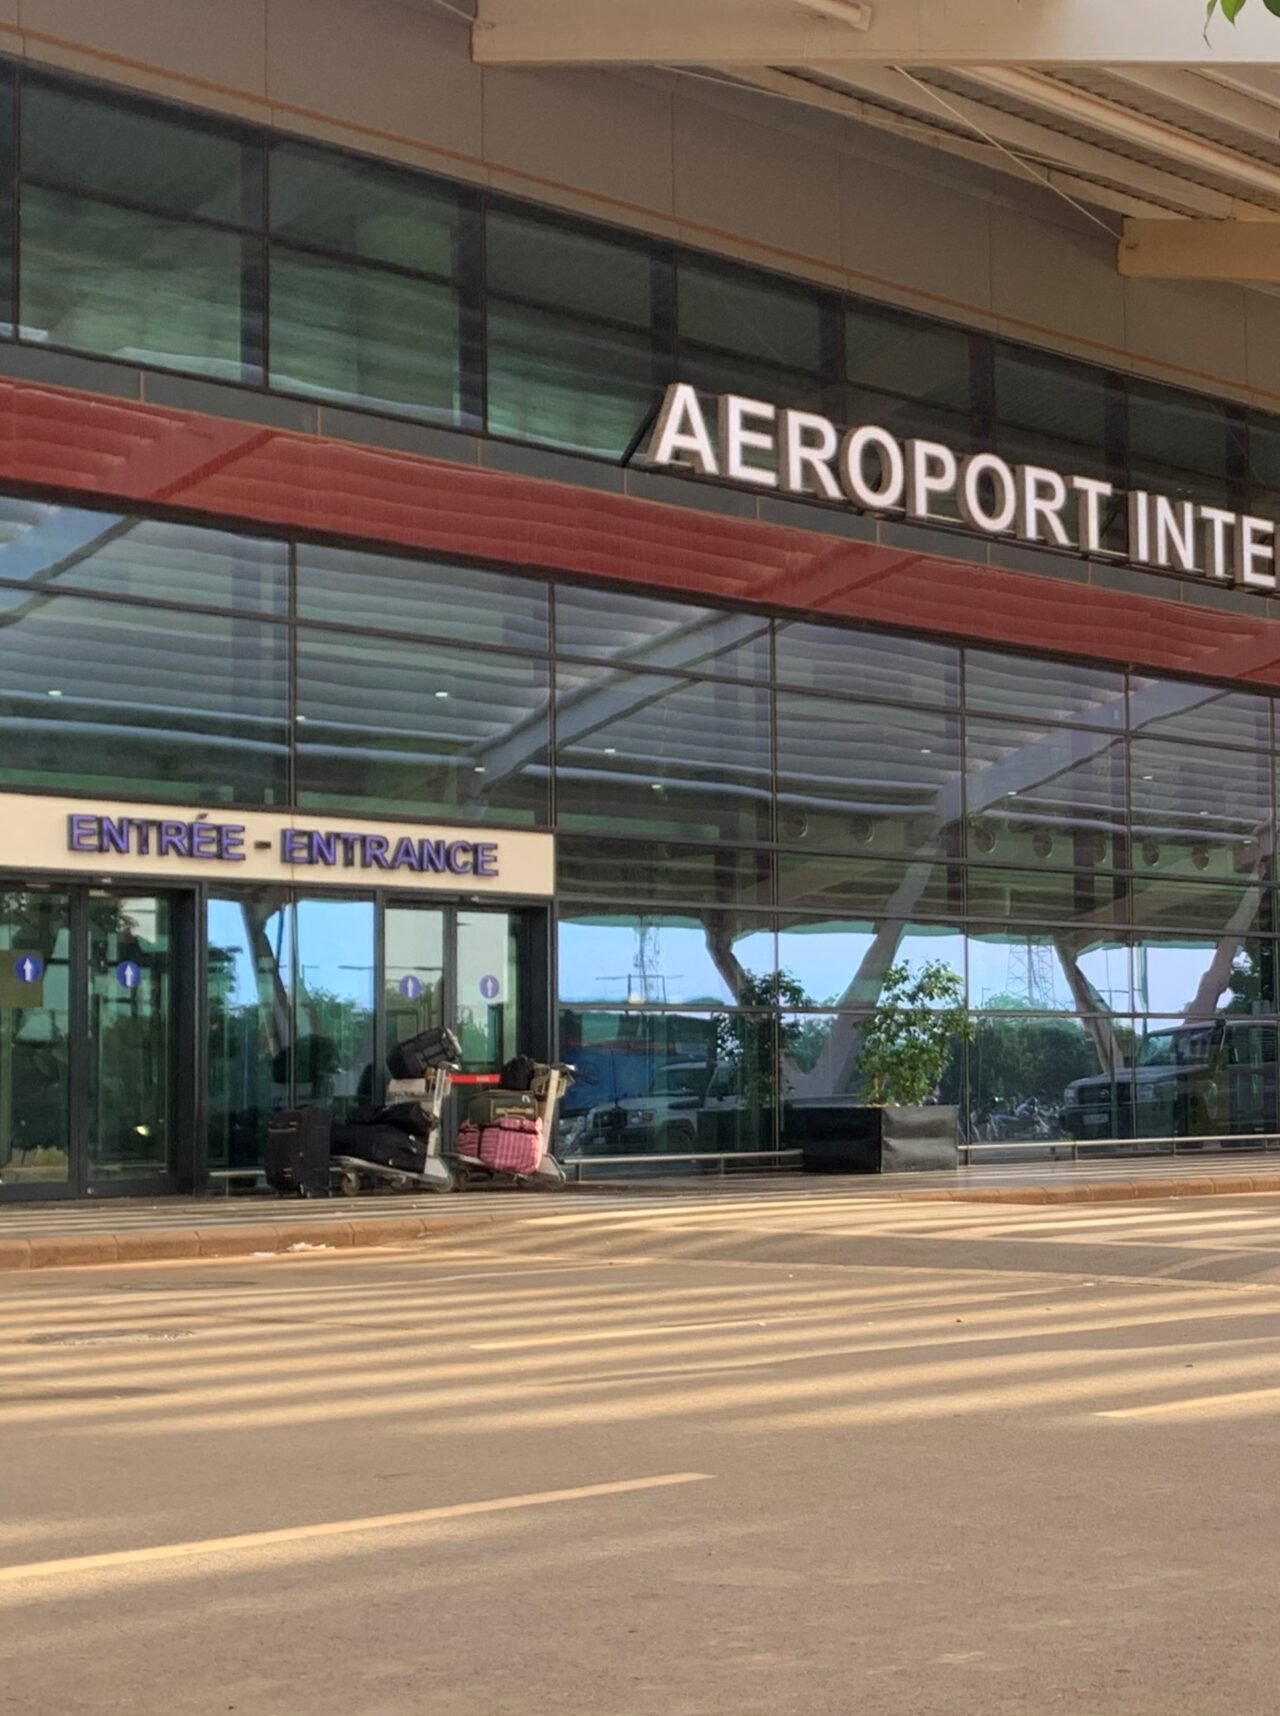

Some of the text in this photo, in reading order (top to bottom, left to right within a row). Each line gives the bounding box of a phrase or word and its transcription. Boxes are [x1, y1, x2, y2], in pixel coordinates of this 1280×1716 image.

[647, 383, 1112, 552] AEROPORT
[68, 813, 246, 861] ENTRÉE
[281, 828, 499, 877] ENTRANCE
